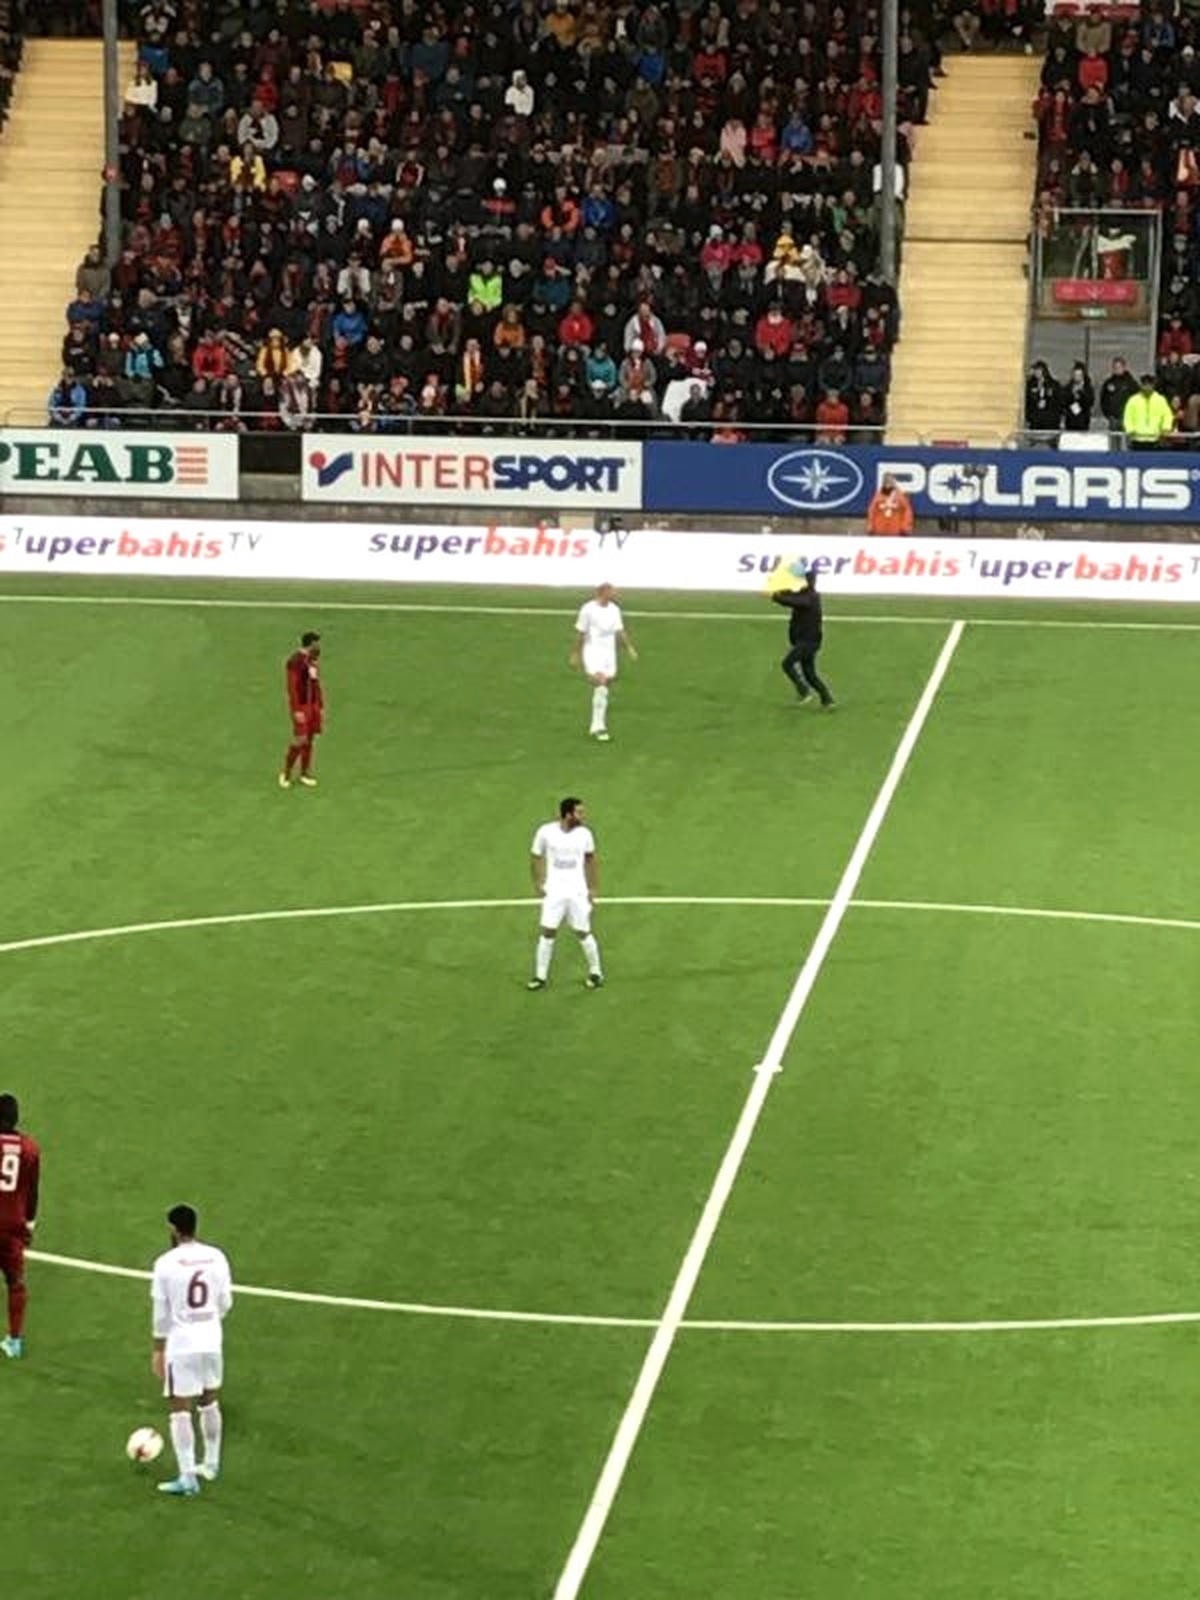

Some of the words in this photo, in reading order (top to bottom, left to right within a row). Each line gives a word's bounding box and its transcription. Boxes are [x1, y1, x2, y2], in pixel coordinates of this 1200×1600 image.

[0, 442, 174, 484] EAB
[361, 452, 626, 492] INTERSPORT
[877, 461, 1192, 510] POLARIS
[25, 530, 224, 562] uperbahis
[368, 518, 589, 560] superbahis
[979, 553, 1183, 585] uperbahis
[187, 1269, 209, 1309] 6
